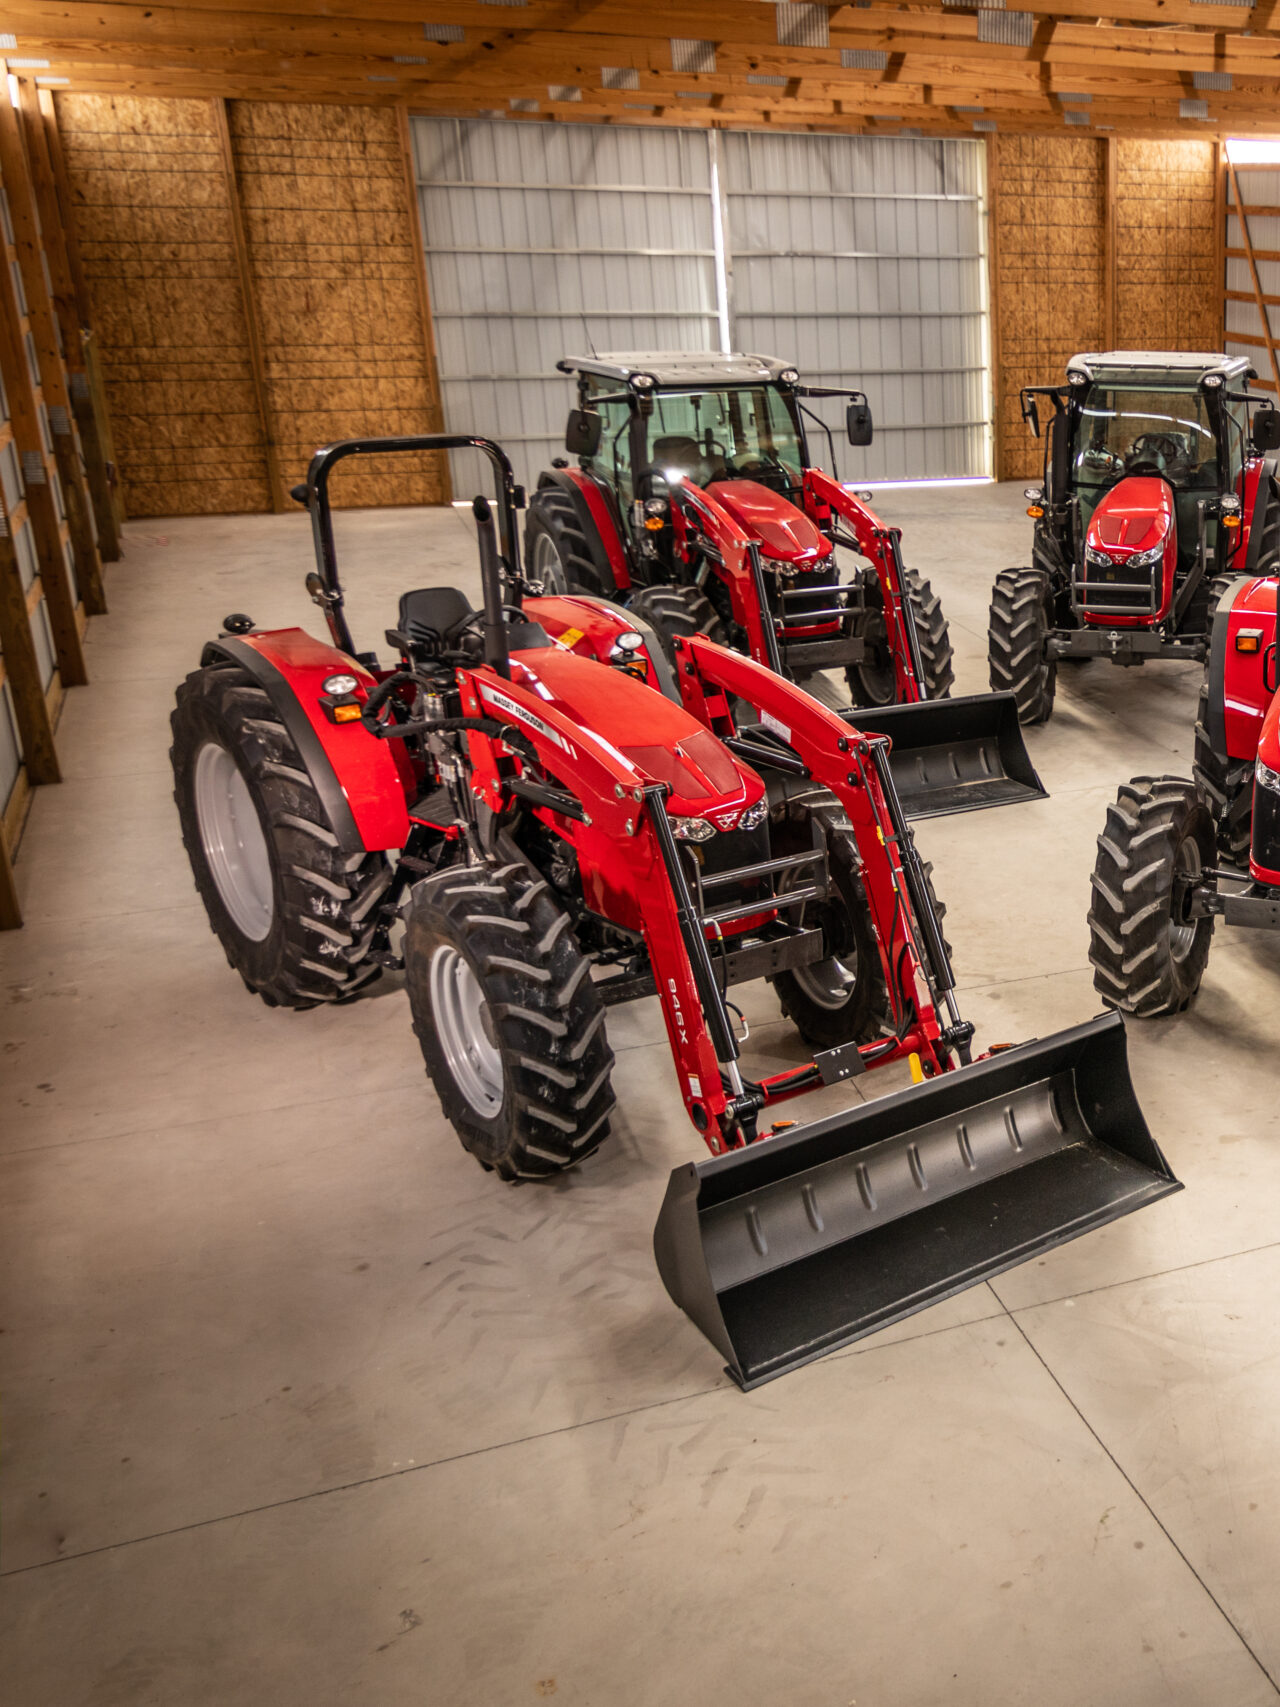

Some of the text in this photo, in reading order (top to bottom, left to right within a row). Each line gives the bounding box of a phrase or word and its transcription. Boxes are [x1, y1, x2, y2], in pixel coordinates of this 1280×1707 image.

[493, 694, 544, 731] MASSEY FERGUSON
[668, 978, 688, 1044] 946X
